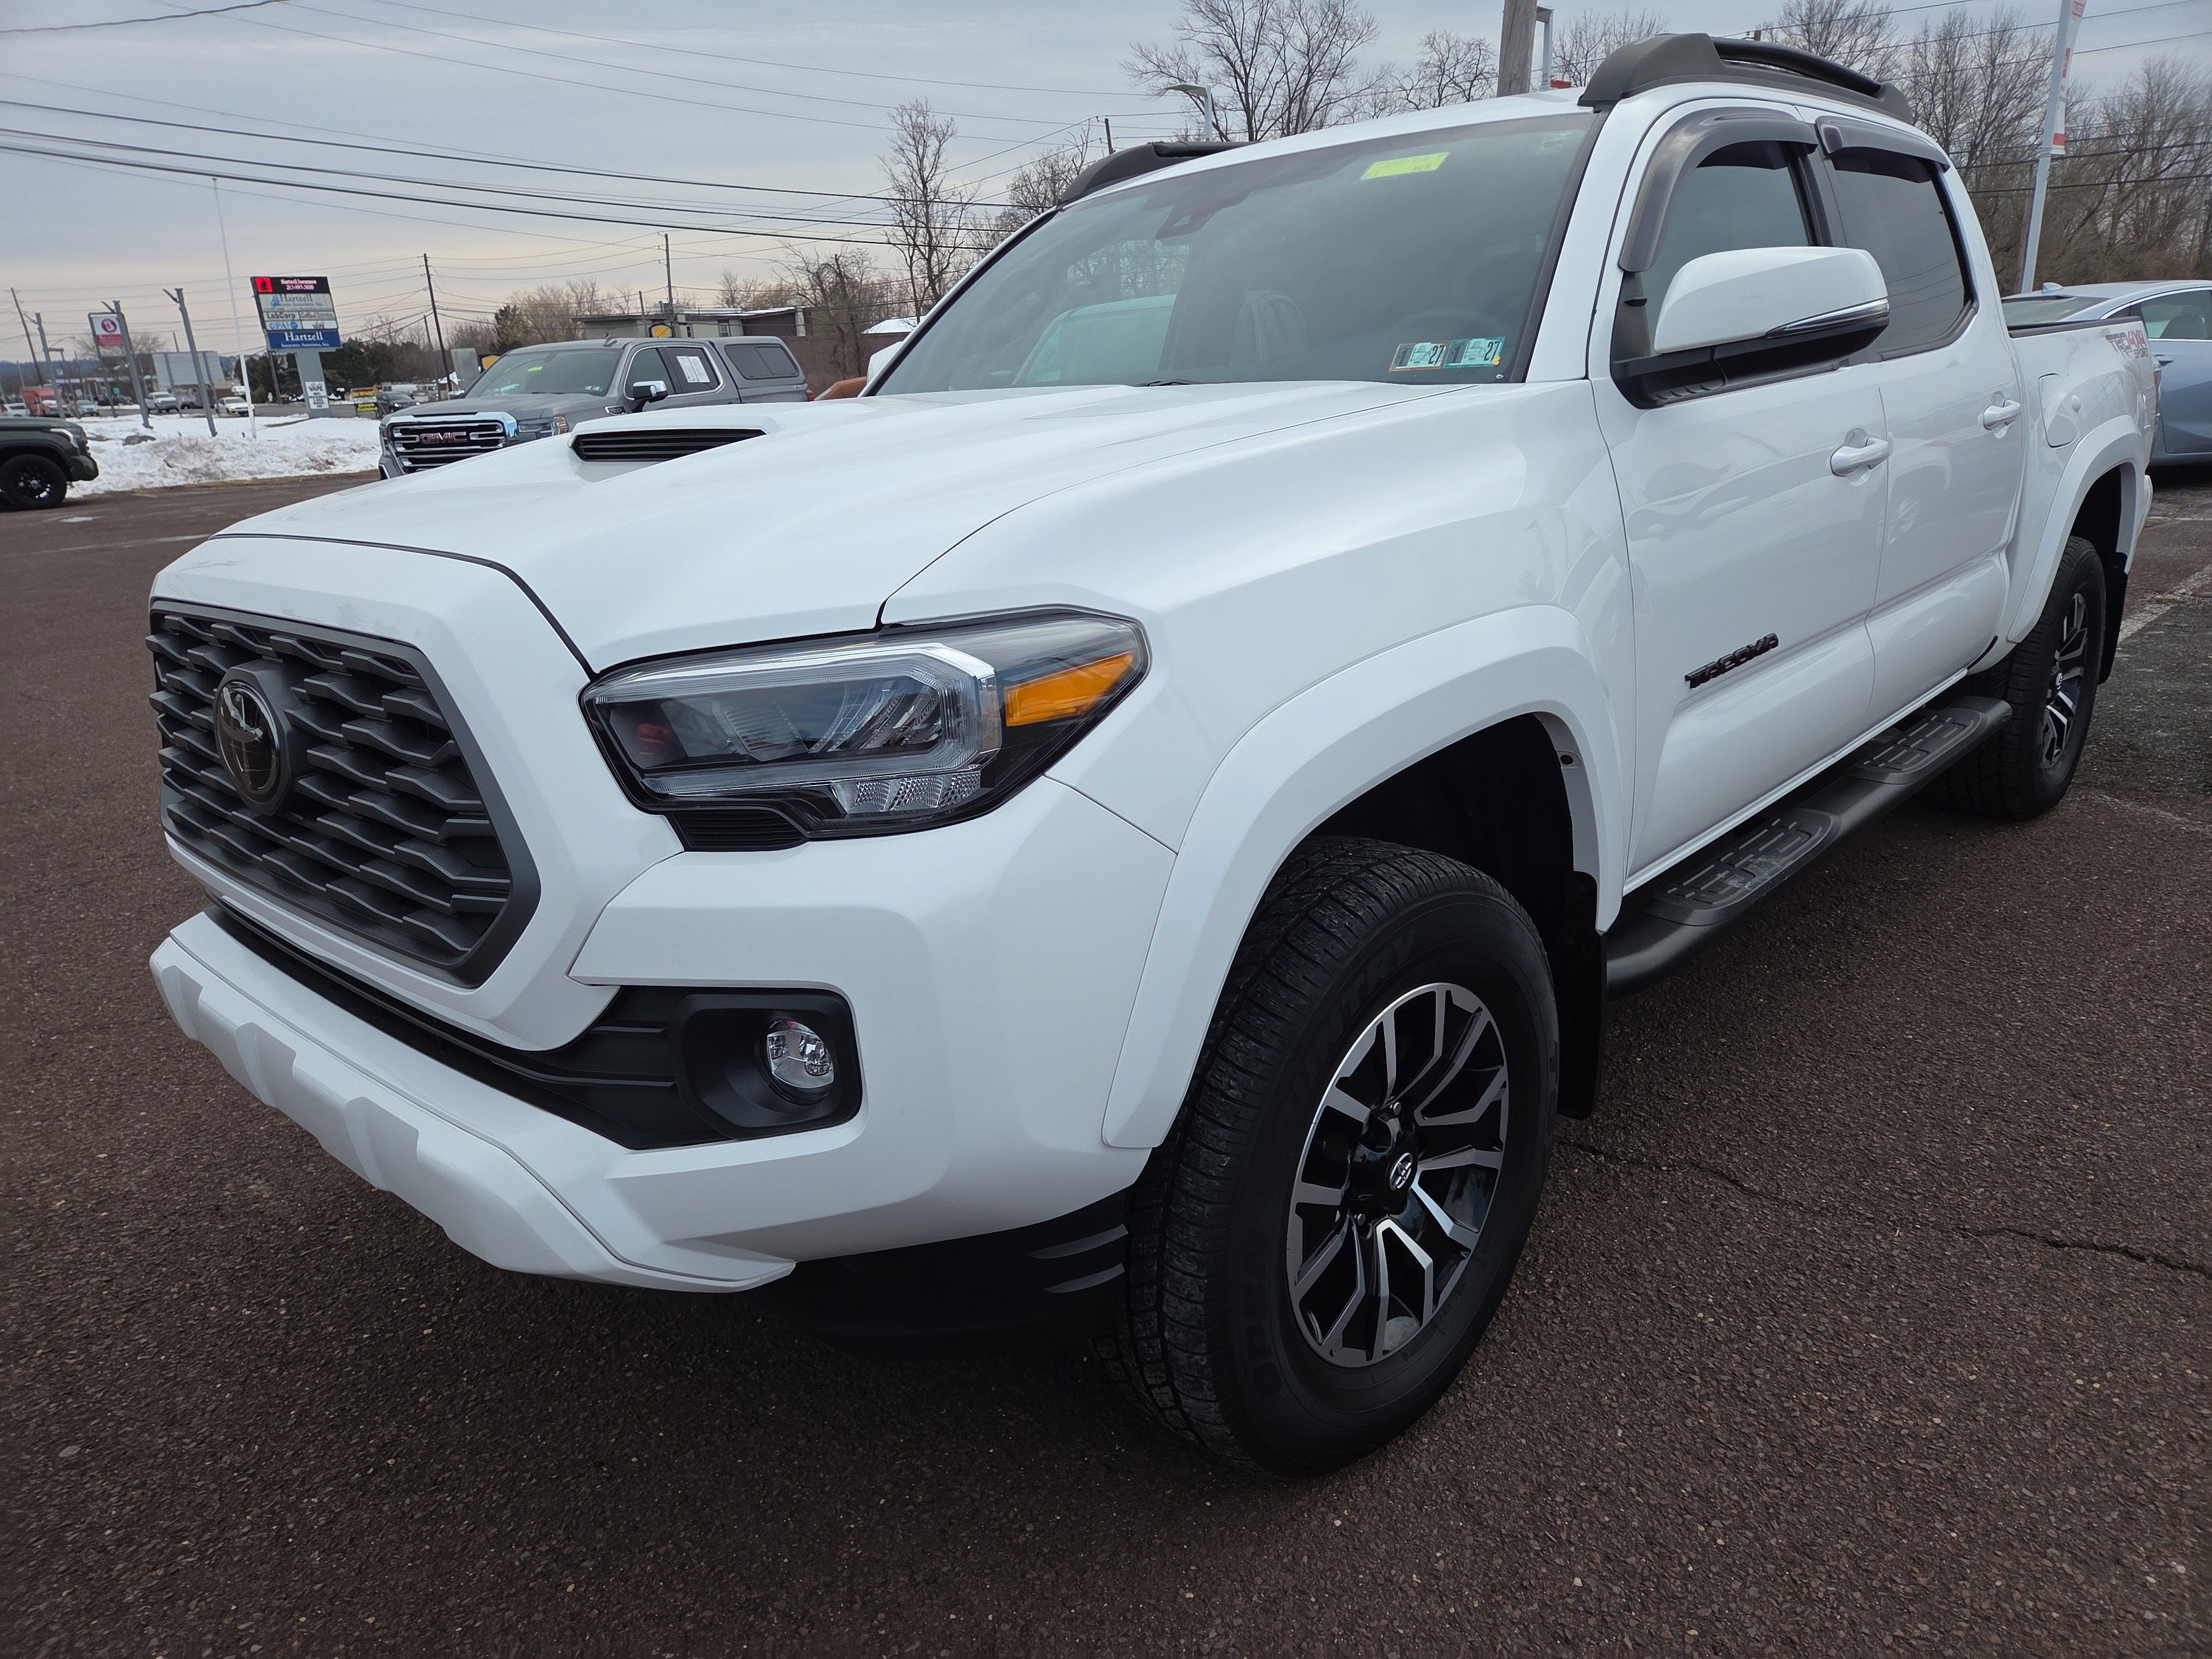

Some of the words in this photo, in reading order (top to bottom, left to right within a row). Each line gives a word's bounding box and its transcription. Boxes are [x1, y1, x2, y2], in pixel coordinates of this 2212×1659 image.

[279, 293, 313, 302] Hartzell
[267, 312, 296, 320] LabCorp
[284, 331, 324, 341] Hartzell
[1451, 344, 1462, 364] 1
[1483, 340, 1501, 363] 27
[2105, 332, 2133, 359] TRD
[1398, 349, 1408, 367] 1
[1428, 345, 1445, 366] 27
[420, 431, 467, 445] GMC
[1684, 632, 1779, 689] TACOMA
